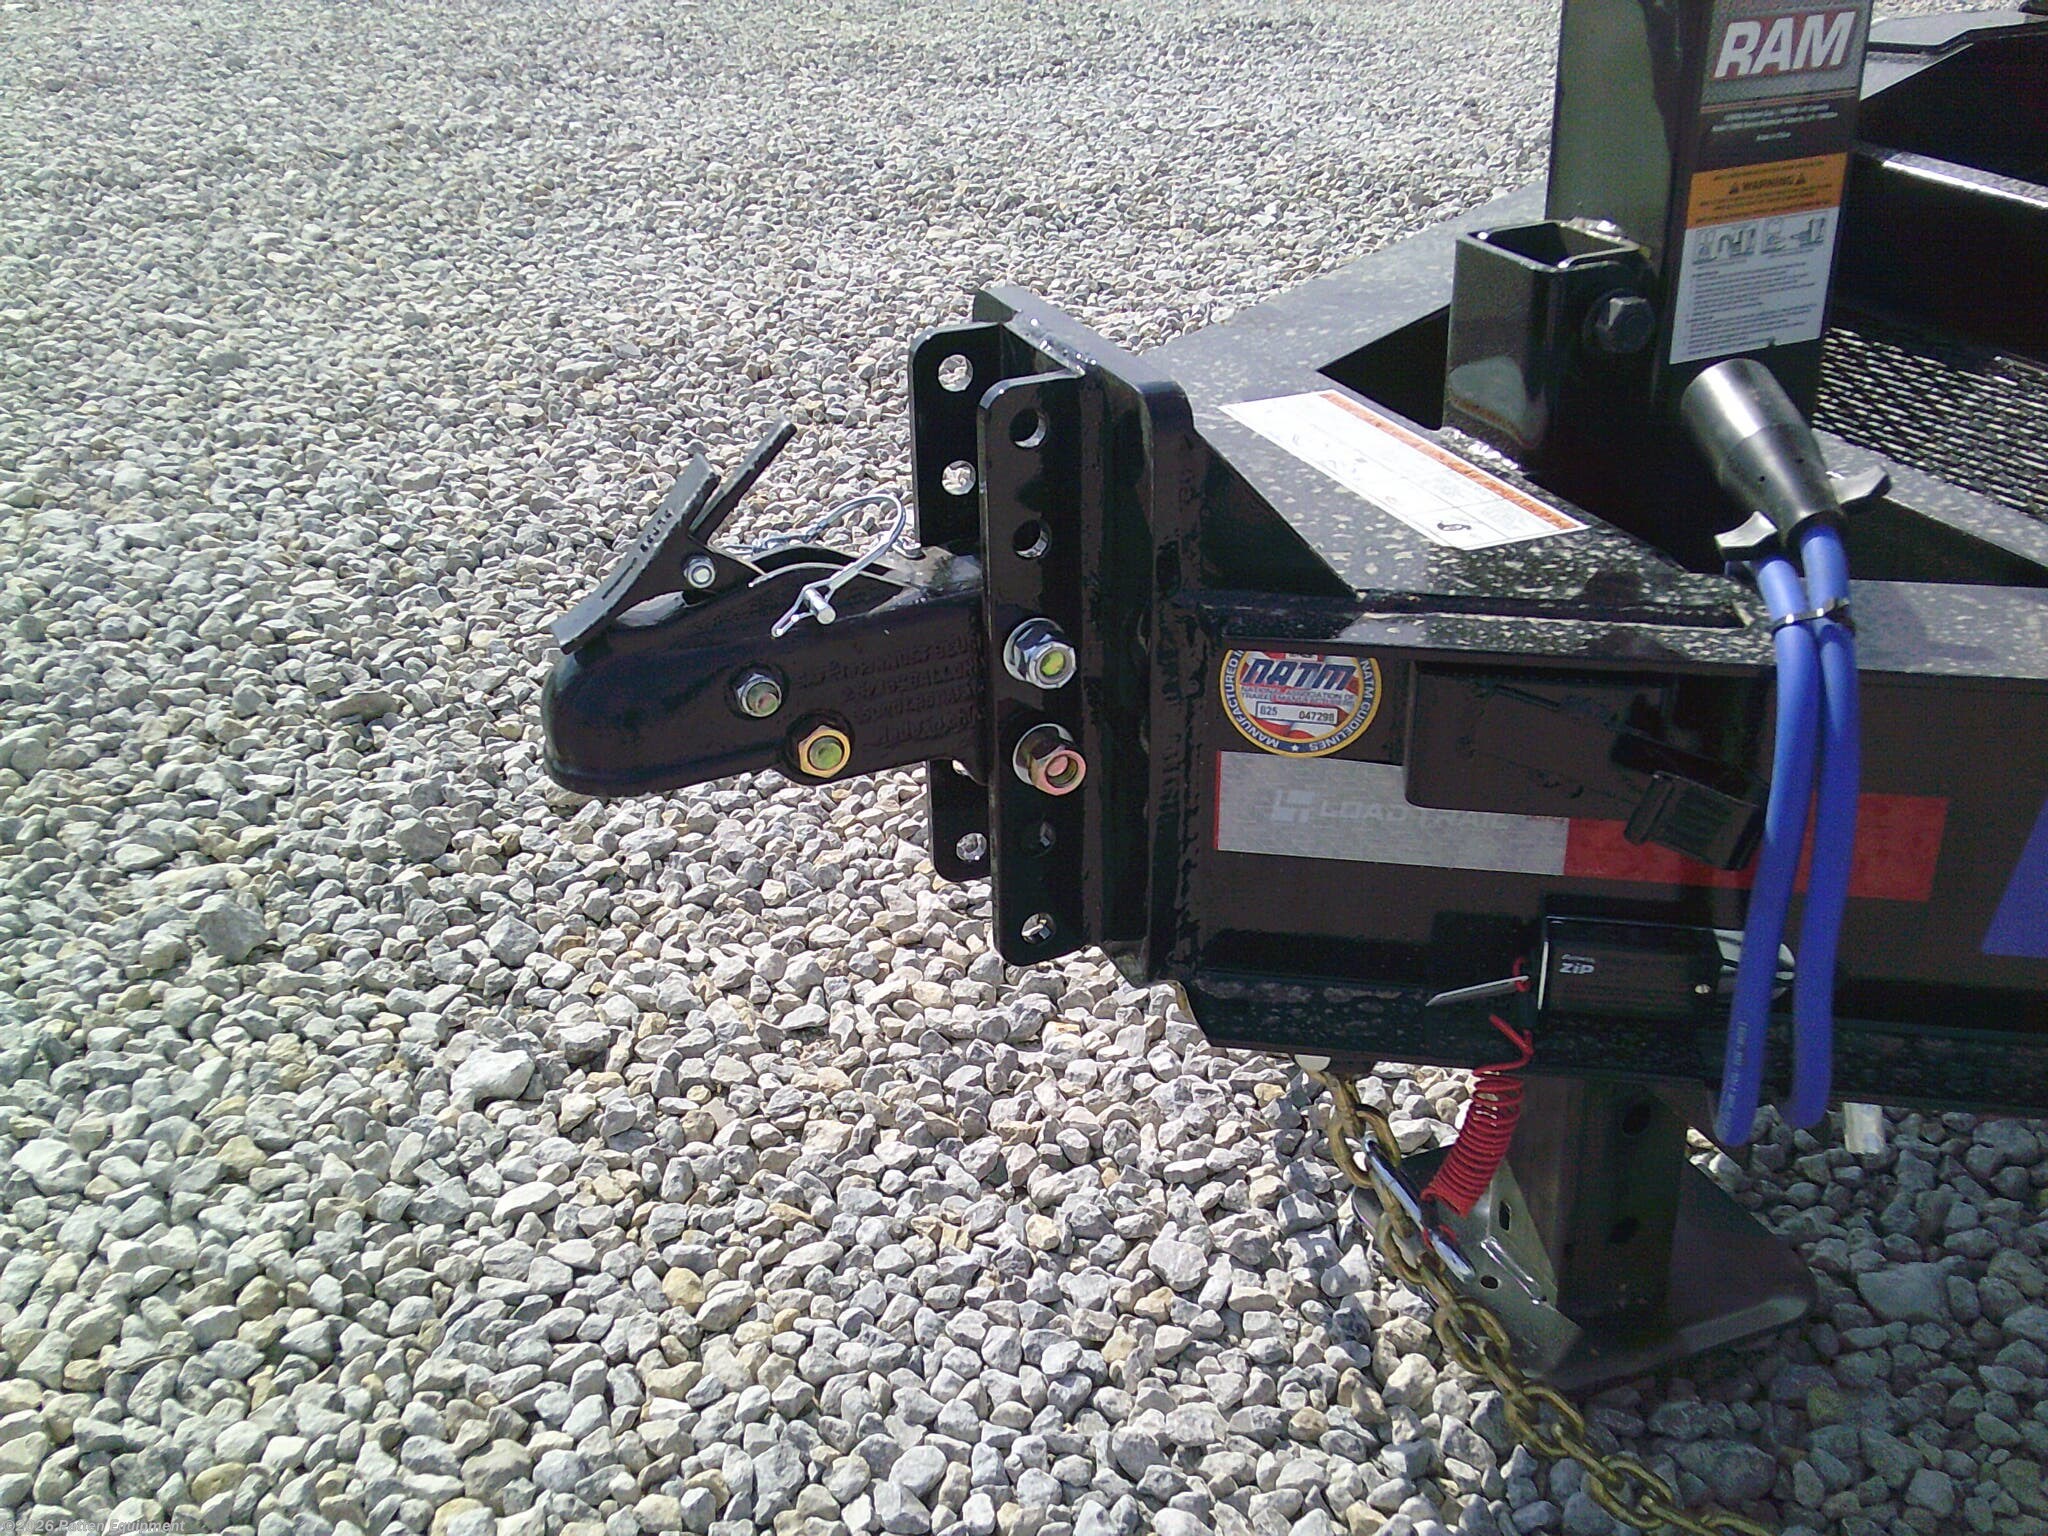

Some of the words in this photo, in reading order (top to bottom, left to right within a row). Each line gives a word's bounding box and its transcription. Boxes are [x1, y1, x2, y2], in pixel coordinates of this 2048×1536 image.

[1714, 11, 1857, 79] RAM
[1242, 658, 1358, 691] NATM
[1360, 659, 1375, 700] NATM
[1224, 656, 1279, 748] MANUFACTURED
[1308, 700, 1371, 752] GUIDELINES
[1320, 800, 1409, 820] LOAD
